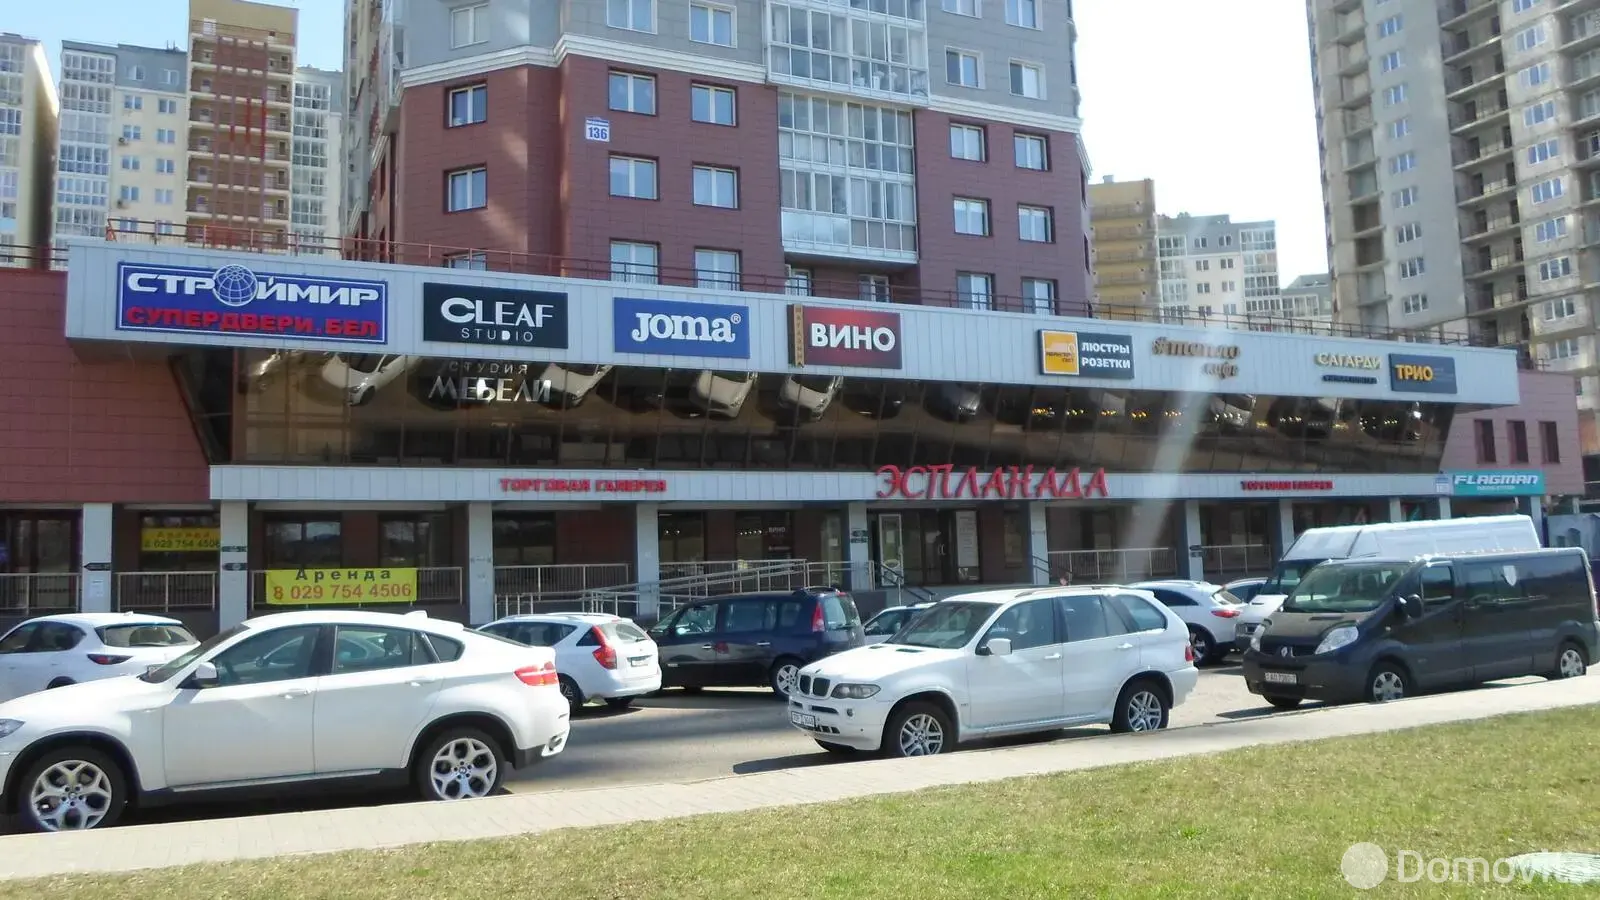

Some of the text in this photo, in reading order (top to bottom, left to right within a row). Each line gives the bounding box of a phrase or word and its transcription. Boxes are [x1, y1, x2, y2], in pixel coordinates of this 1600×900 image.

[588, 126, 608, 140] 136
[127, 264, 379, 306] СТРОЙМИР
[126, 305, 378, 337] СУПЕРДВЕРИ.БЕЛ
[440, 297, 555, 328] CLEAF
[461, 327, 534, 343] STUDIO
[811, 322, 896, 352] ВИНО
[1081, 341, 1130, 354] ЛЮСТРЫ
[1081, 357, 1131, 369] РОЗЕТКИ
[1315, 353, 1381, 370] САГАРДИ
[1395, 364, 1434, 381] ТРИО
[428, 375, 552, 403] МЕБЕЛИ
[499, 478, 667, 493] ТОРГОВАЯ ГАЛЕРЕЯ
[876, 463, 1109, 499] ЭСПЛАНАДА
[1454, 474, 1539, 485] FLAGMAN
[295, 569, 391, 583] Аренда
[273, 583, 412, 600] 8 029 754 4506
